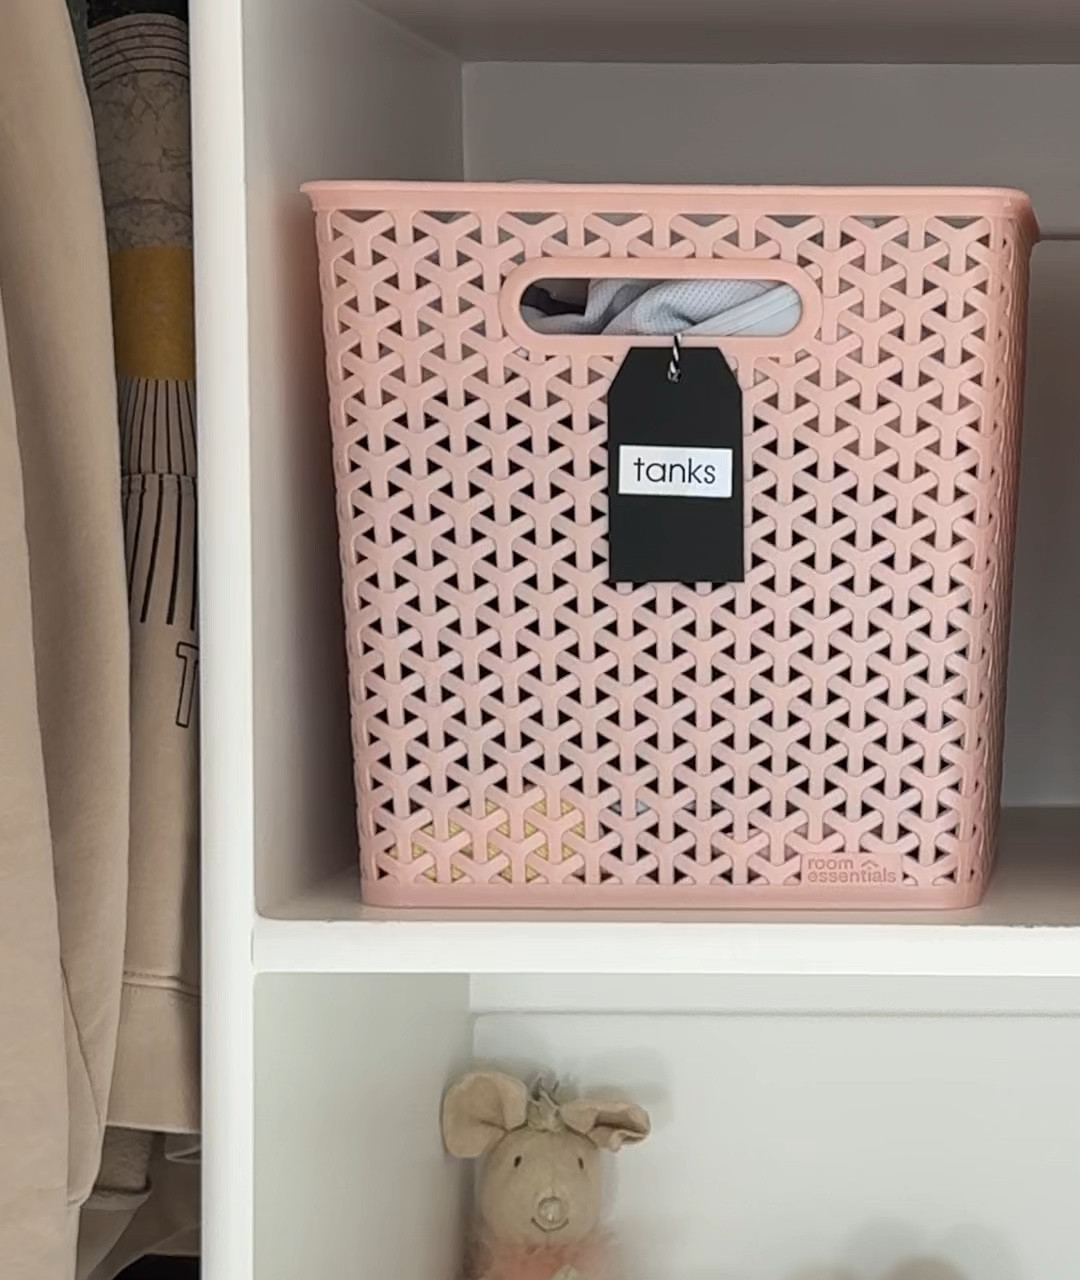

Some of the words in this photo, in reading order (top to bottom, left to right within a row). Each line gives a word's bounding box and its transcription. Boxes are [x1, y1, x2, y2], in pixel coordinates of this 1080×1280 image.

[633, 457, 716, 484] tanks
[808, 858, 854, 870] room
[807, 867, 896, 883] essentials
